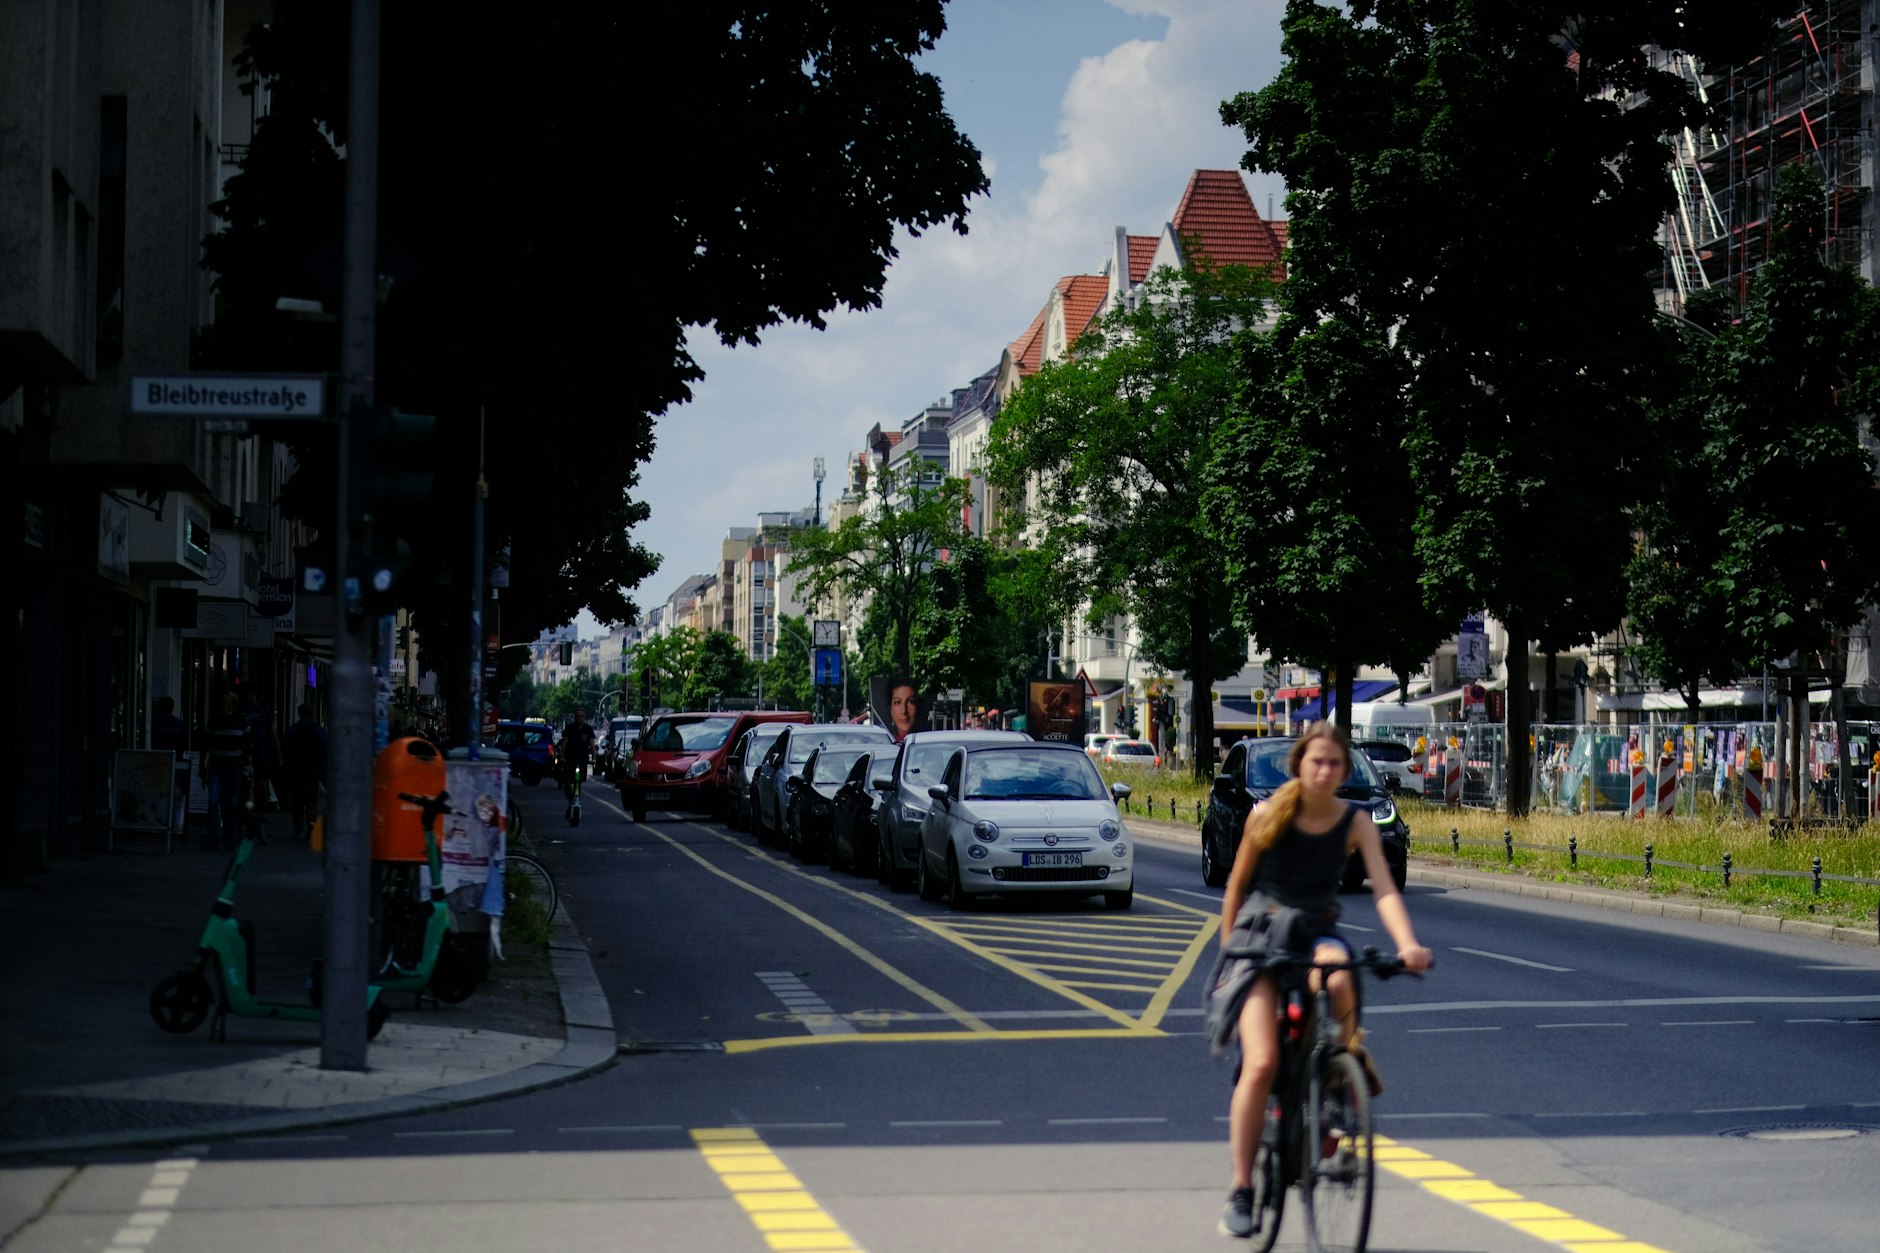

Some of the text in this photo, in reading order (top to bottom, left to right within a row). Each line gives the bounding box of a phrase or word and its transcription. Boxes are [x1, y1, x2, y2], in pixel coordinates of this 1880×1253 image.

[148, 383, 307, 411] Bleibtreustraße
[258, 593, 292, 602] ension
[1029, 855, 1046, 865] LDS
[1064, 854, 1080, 864] 296
